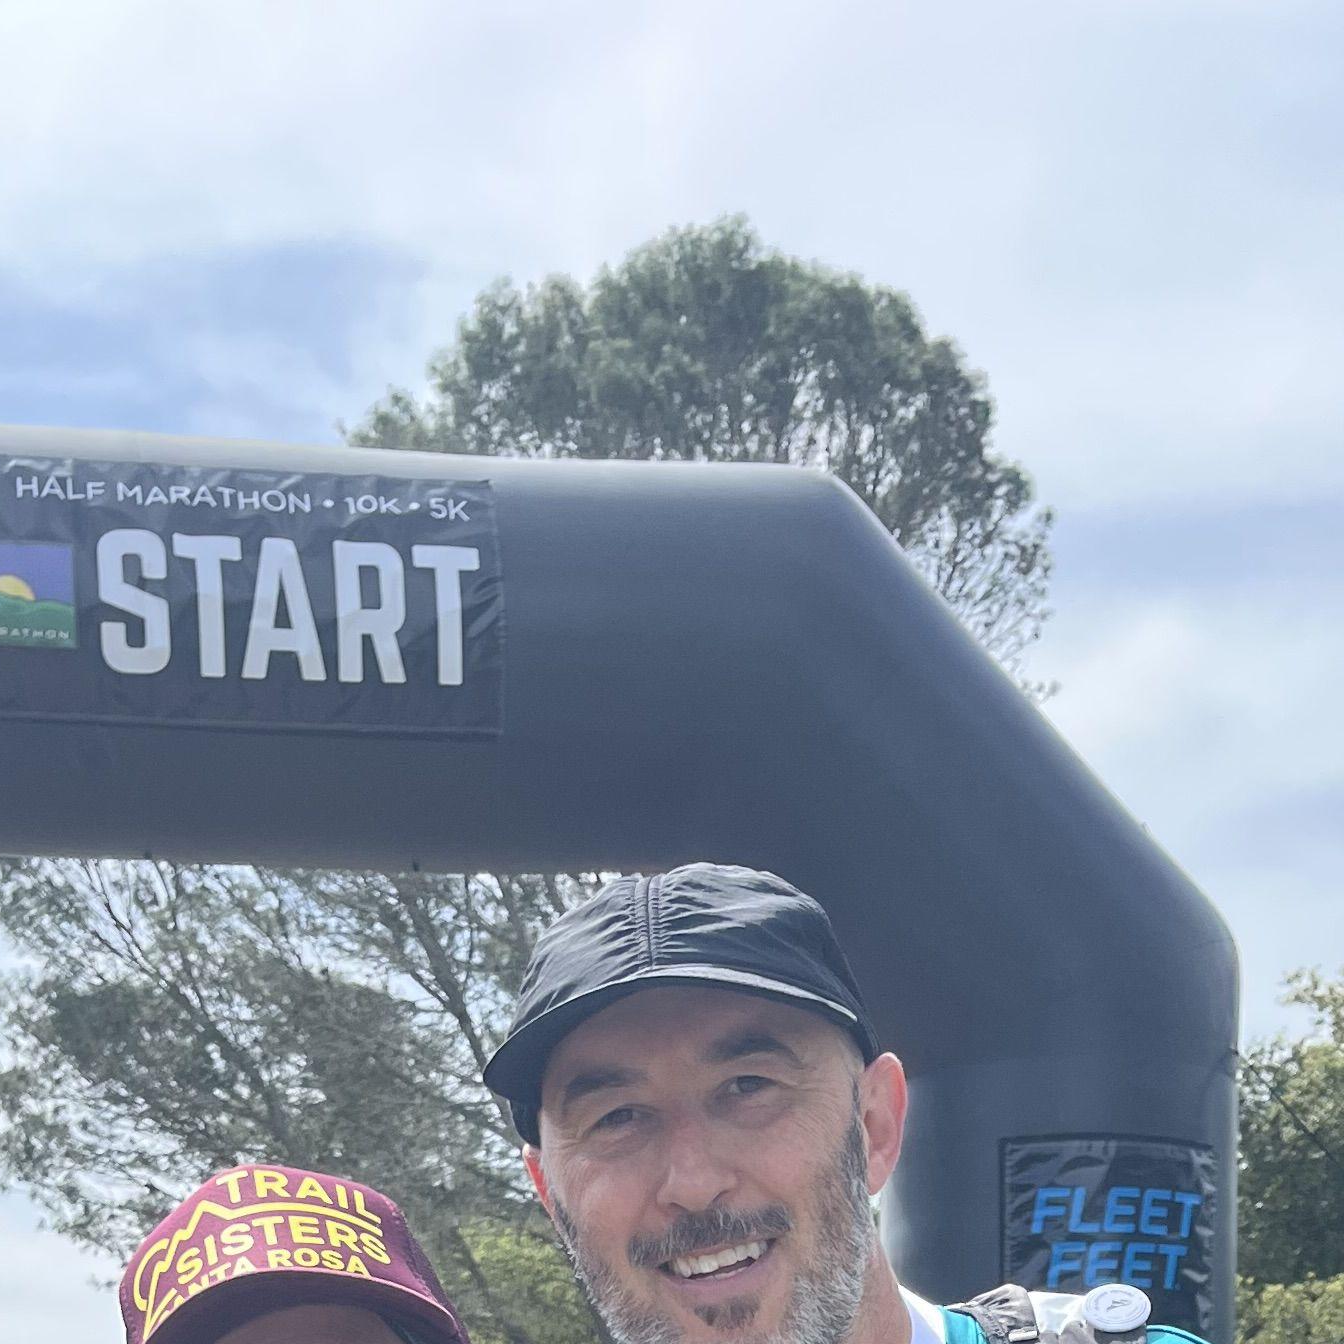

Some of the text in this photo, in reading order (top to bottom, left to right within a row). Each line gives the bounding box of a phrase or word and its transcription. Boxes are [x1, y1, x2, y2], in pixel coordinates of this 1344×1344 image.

[16, 475, 105, 501] HALF
[116, 482, 312, 514] MARATHON
[344, 494, 403, 515] 10K
[429, 498, 471, 522] 5K
[95, 528, 481, 687] START
[216, 1170, 382, 1225] TRAIL
[1030, 1186, 1202, 1239] FLEET
[176, 1214, 391, 1285] SISTERS
[266, 1248, 371, 1278] ROSA
[1046, 1241, 1189, 1291] FEET
